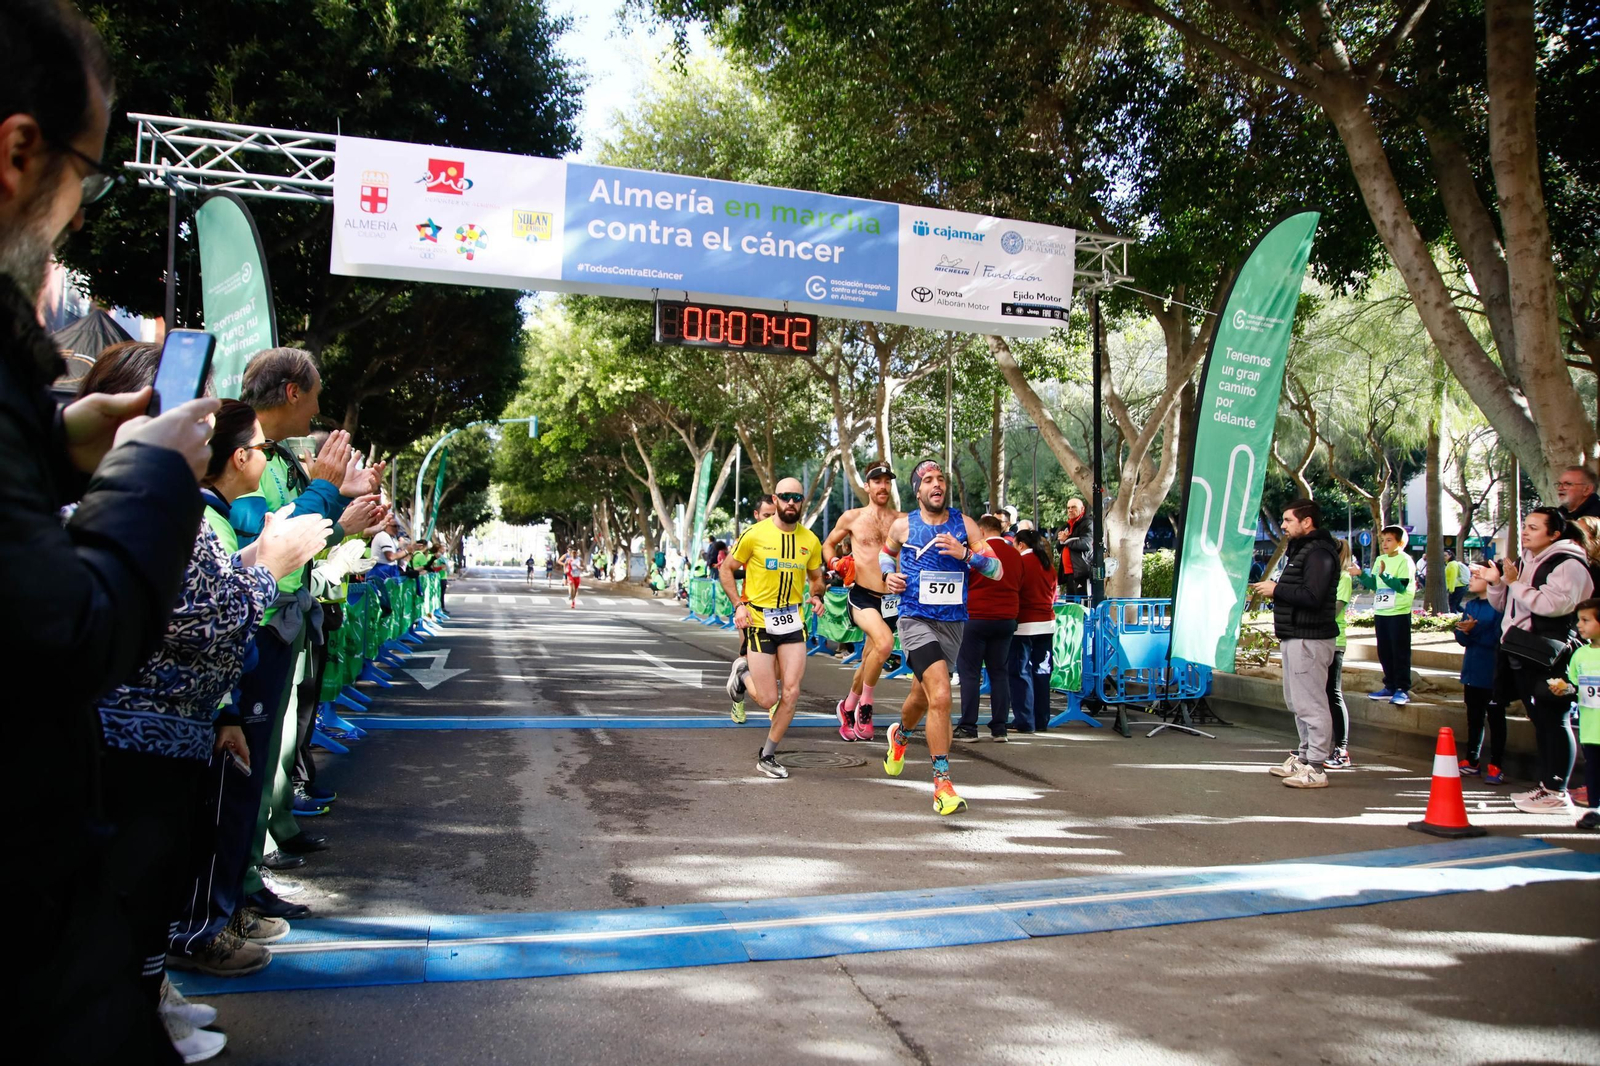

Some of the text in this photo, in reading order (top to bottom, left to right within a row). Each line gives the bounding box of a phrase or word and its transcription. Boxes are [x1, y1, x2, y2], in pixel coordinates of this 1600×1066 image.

[588, 178, 881, 235] Almería en marcha
[343, 217, 398, 231] ALMERÍA
[933, 226, 985, 241] cajamar
[587, 218, 845, 264] contra el cáncer
[577, 263, 683, 280] #TodosContraElCáncer
[934, 265, 1042, 282] MICHELIN Fundación
[830, 279, 891, 291] asociación española
[831, 286, 851, 294] contra
[858, 288, 878, 297] cáncer
[937, 288, 963, 298] Toyota
[1013, 291, 1062, 302] Ejido Motor
[937, 298, 990, 311] Alborán Motor
[1226, 347, 1272, 368] Tenemos
[1221, 365, 1260, 382] un gran
[1218, 381, 1257, 397] camino
[1215, 396, 1234, 408] por
[1213, 409, 1256, 429] delante
[928, 582, 955, 594] 570
[885, 600, 898, 610] 621
[772, 613, 794, 627] 398
